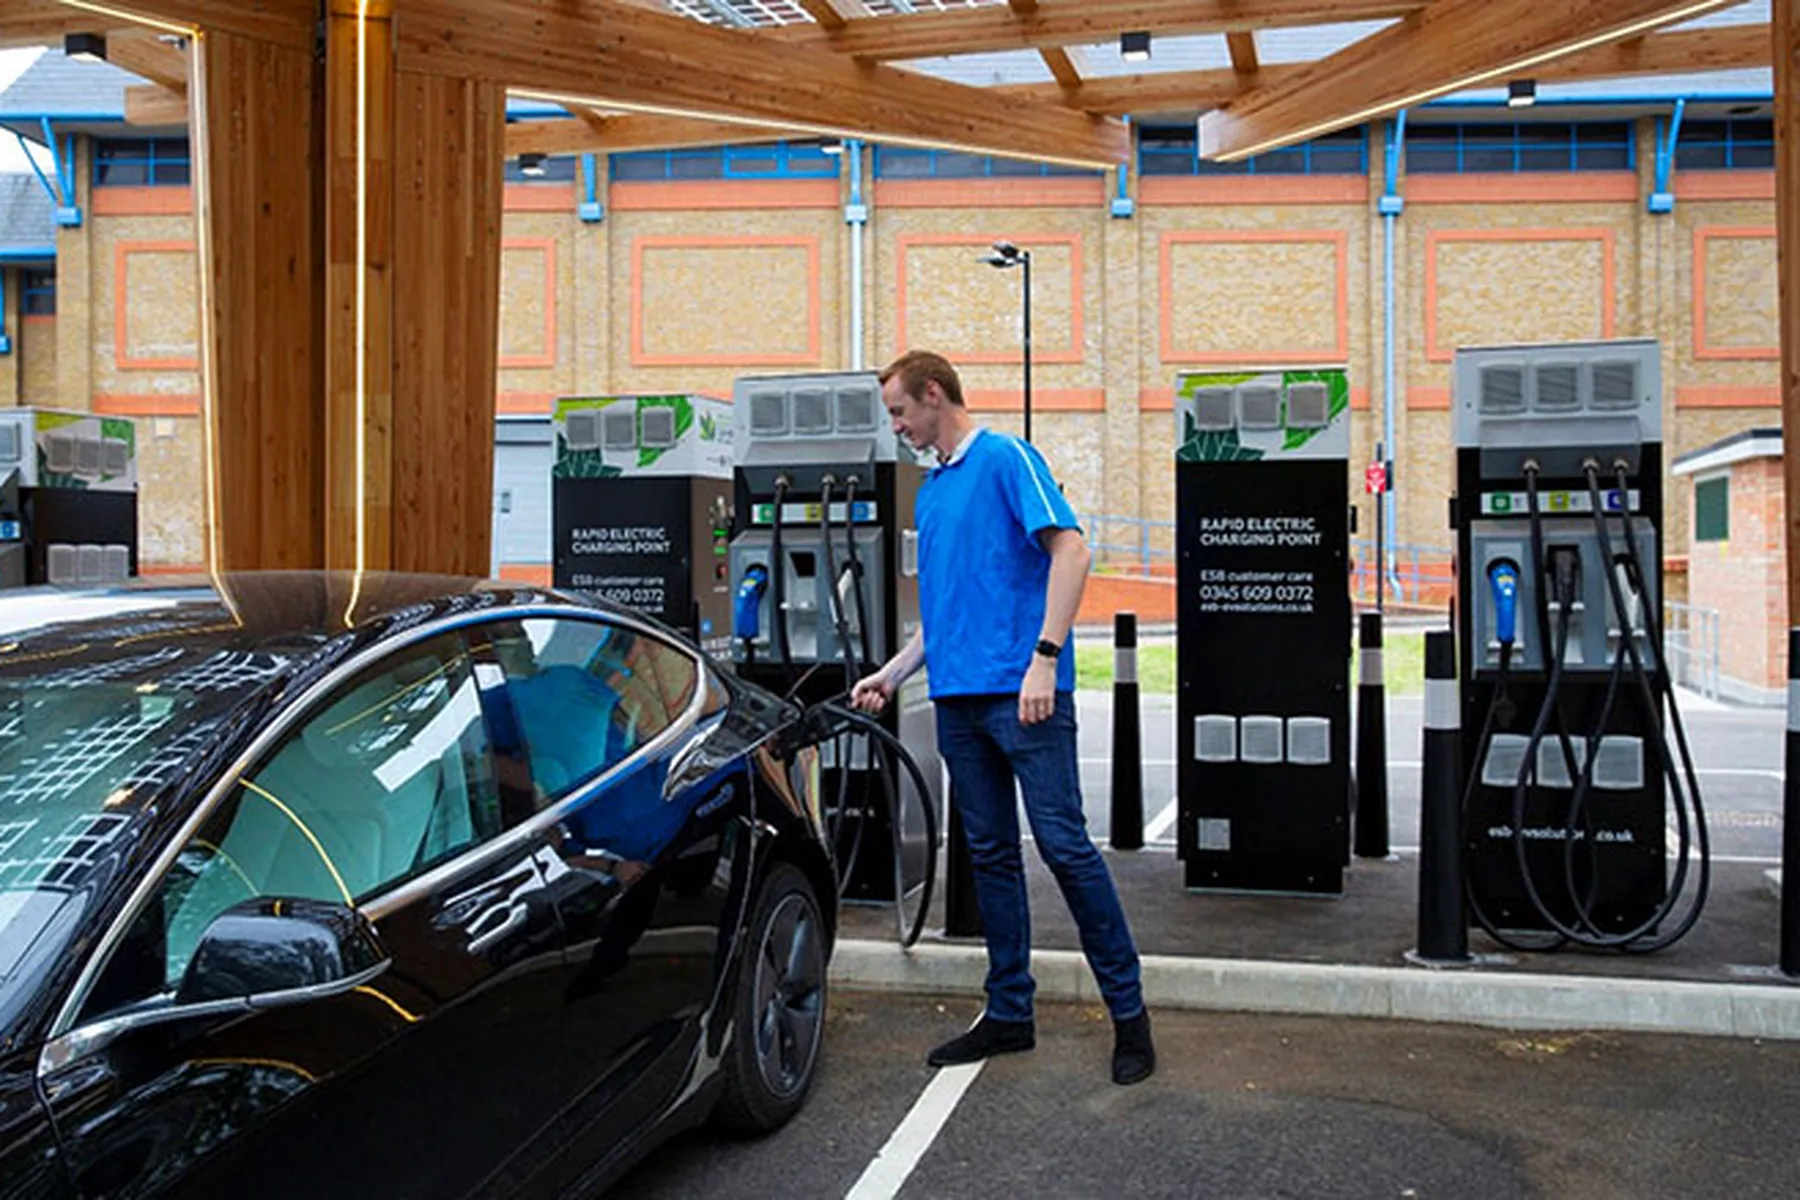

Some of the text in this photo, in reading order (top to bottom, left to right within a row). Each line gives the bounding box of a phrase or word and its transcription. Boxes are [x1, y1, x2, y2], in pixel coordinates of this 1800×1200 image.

[1200, 517, 1316, 531] RAPID ELECTRIC
[572, 527, 665, 540] RAPID ELECTRIC
[1199, 532, 1322, 546] CHARGING POINT
[572, 540, 671, 554] CHARGING POINT
[594, 575, 642, 585] customer
[643, 577, 664, 585] care
[1200, 569, 1314, 581] ESB customer care
[605, 588, 631, 602] 609
[632, 588, 665, 602] 0372
[1199, 585, 1314, 600] 0345 609 0372
